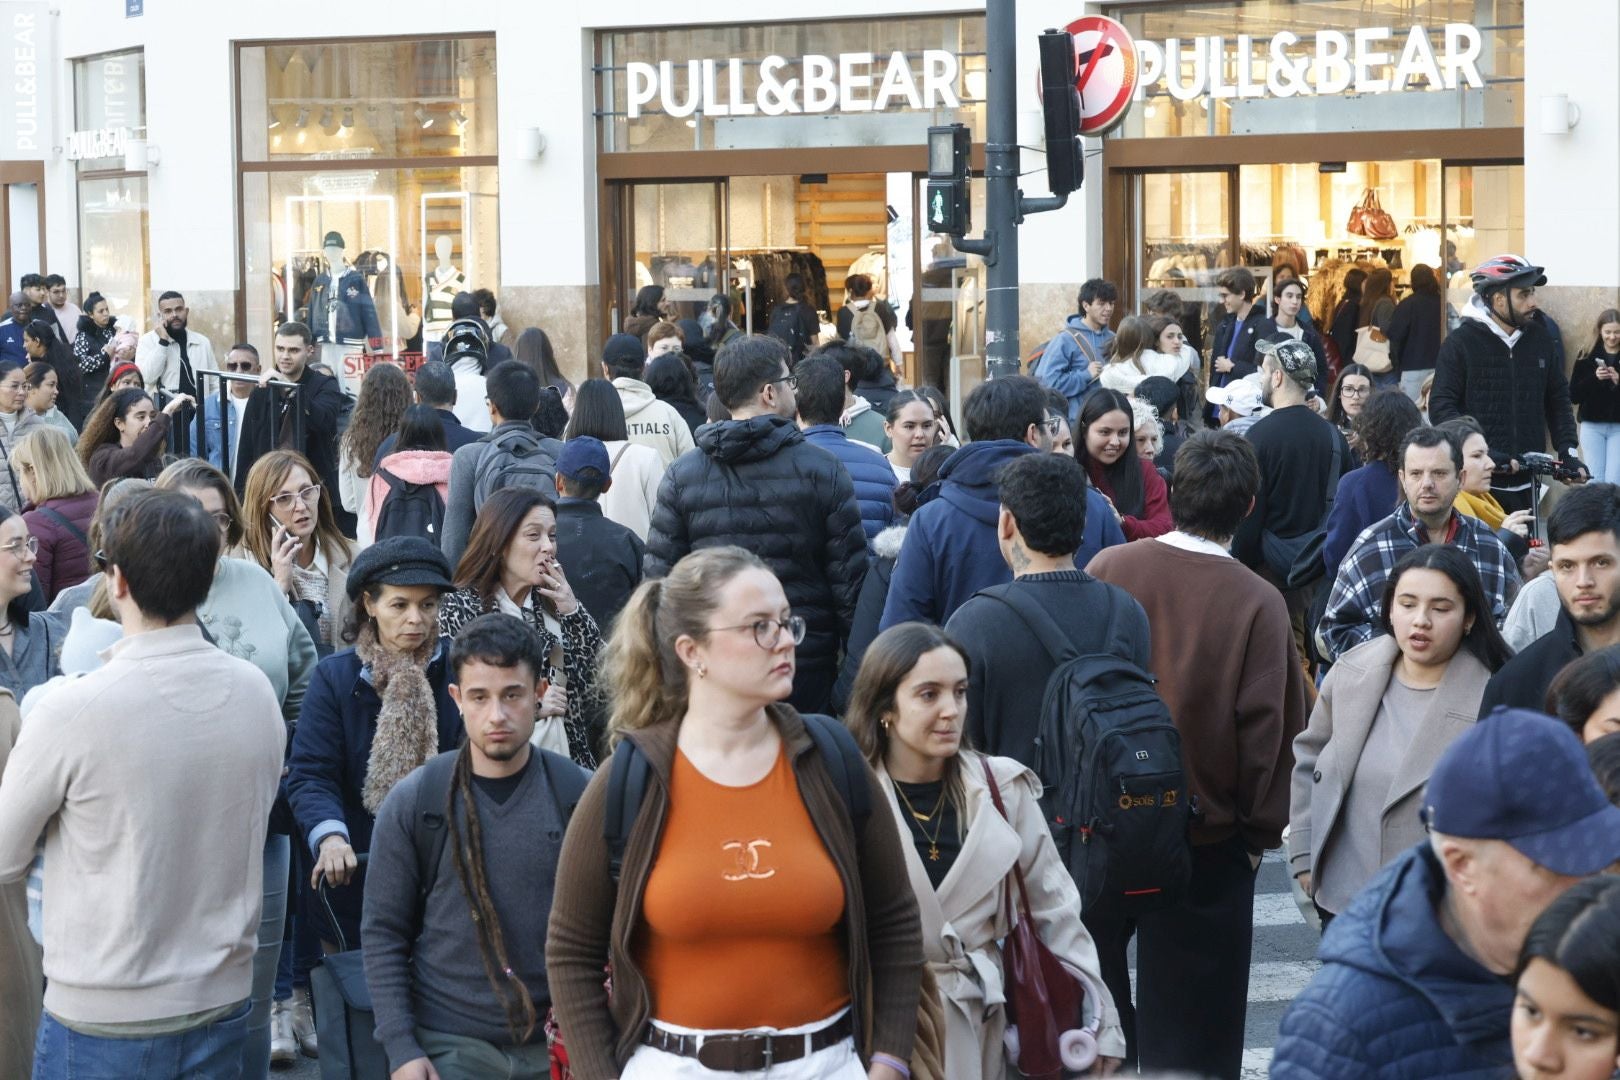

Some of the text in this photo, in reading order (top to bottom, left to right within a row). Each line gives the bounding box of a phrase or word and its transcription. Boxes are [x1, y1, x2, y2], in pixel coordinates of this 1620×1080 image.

[14, 12, 38, 151] PULL&BEAR
[626, 49, 961, 118] PULL&BEAR
[1132, 23, 1485, 102] PULL&BEAR
[344, 355, 428, 375] STRER
